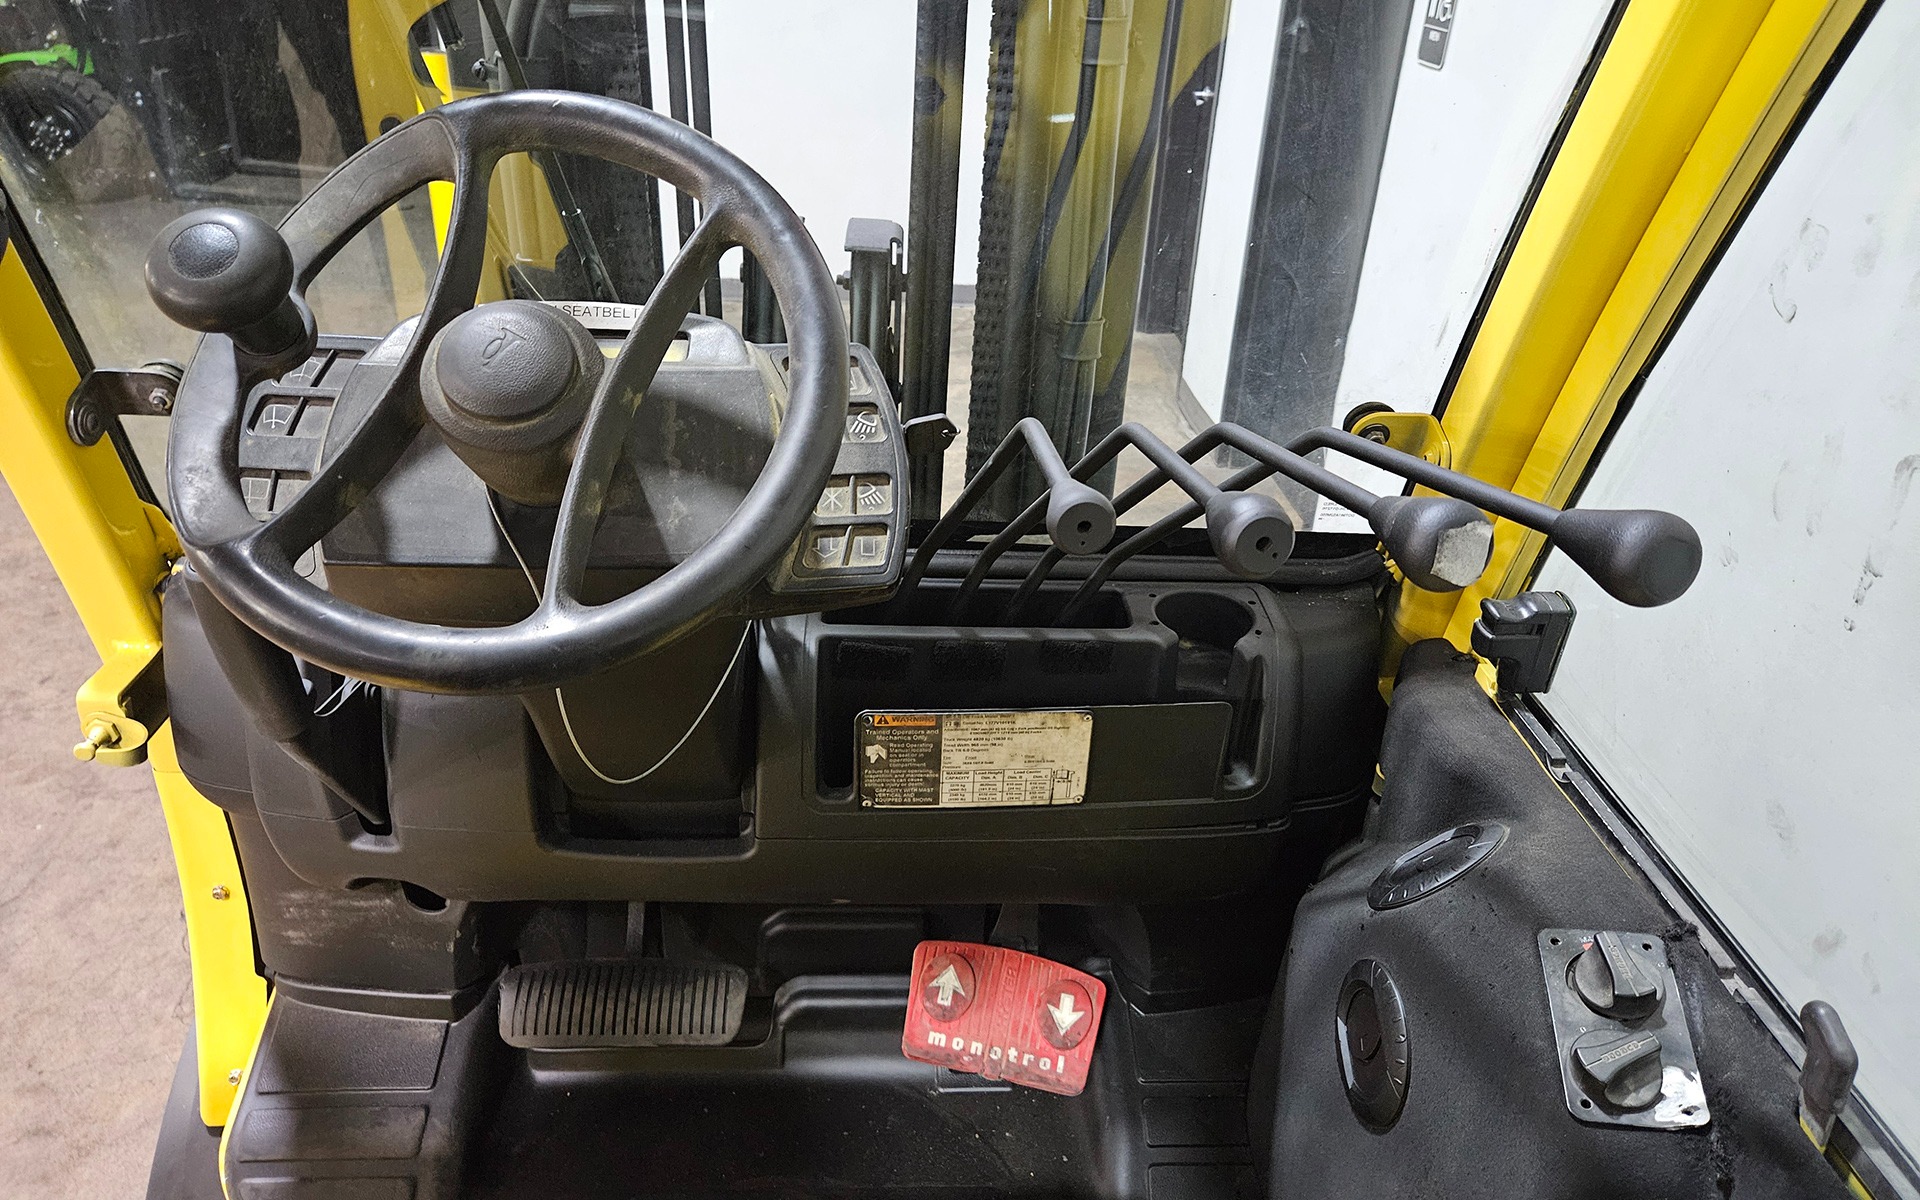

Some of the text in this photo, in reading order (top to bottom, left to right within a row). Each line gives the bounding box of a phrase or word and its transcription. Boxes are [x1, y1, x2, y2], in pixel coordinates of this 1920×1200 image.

[562, 304, 640, 319] SEATBELT
[906, 742, 933, 750] Operating
[927, 1030, 1065, 1074] monotrol
